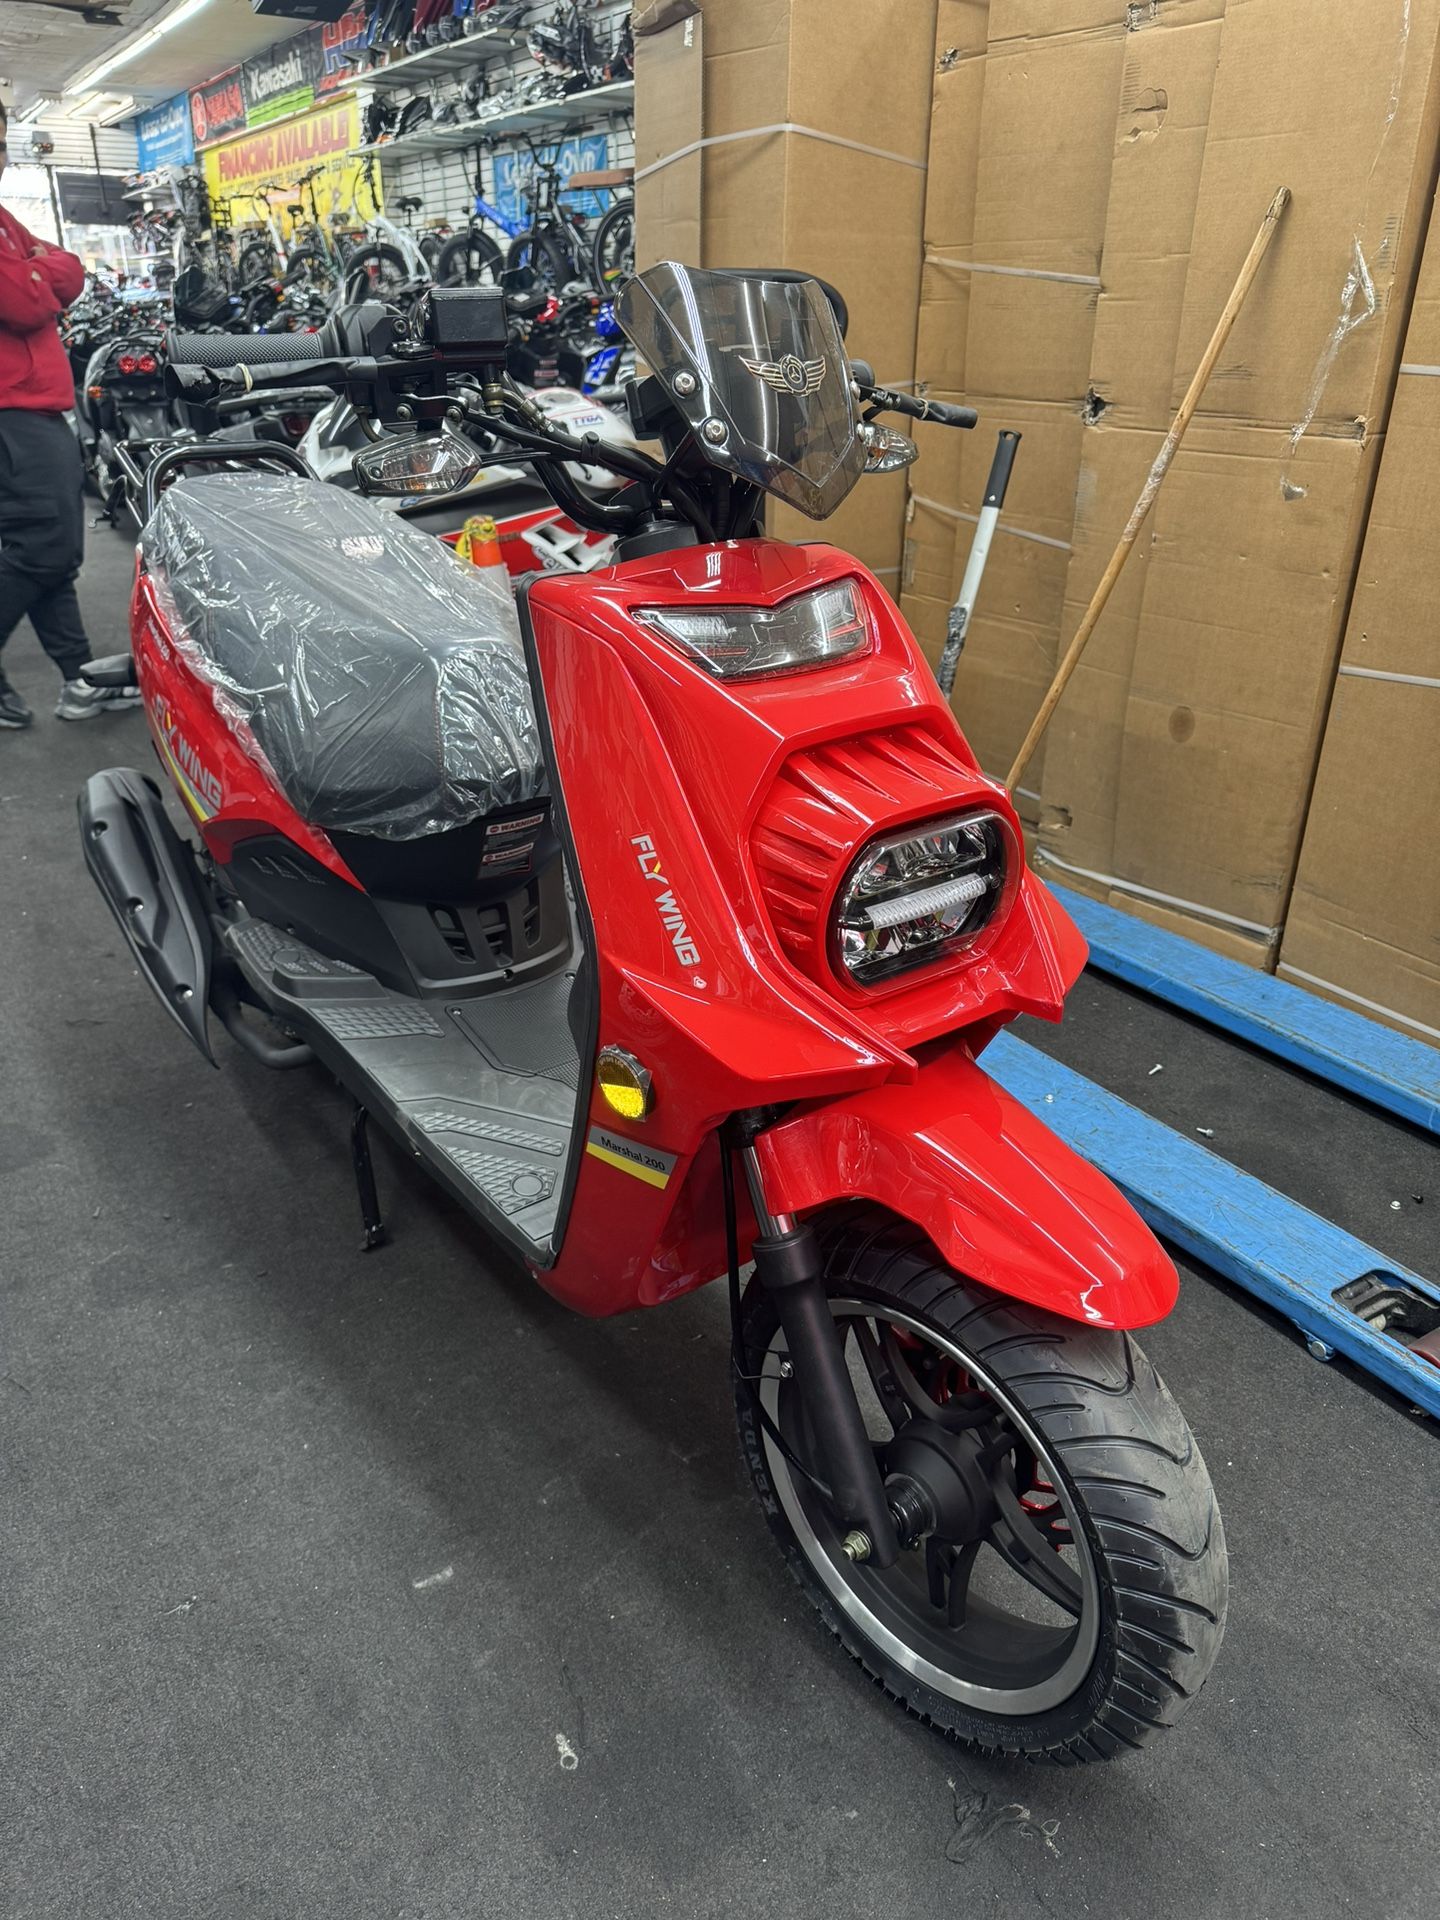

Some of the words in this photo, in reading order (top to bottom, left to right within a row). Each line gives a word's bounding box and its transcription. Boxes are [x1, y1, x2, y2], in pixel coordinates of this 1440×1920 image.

[250, 49, 303, 102] Kawasaki
[218, 135, 275, 183] FINANCING
[276, 109, 350, 168] AVAILABLE
[178, 732, 222, 810] WING
[501, 815, 542, 831] WARNING
[630, 834, 669, 885] FLY
[655, 889, 701, 967] WING
[600, 1136, 643, 1162] Marshal
[644, 1156, 666, 1171] 200
[741, 1407, 779, 1515] KENDA
